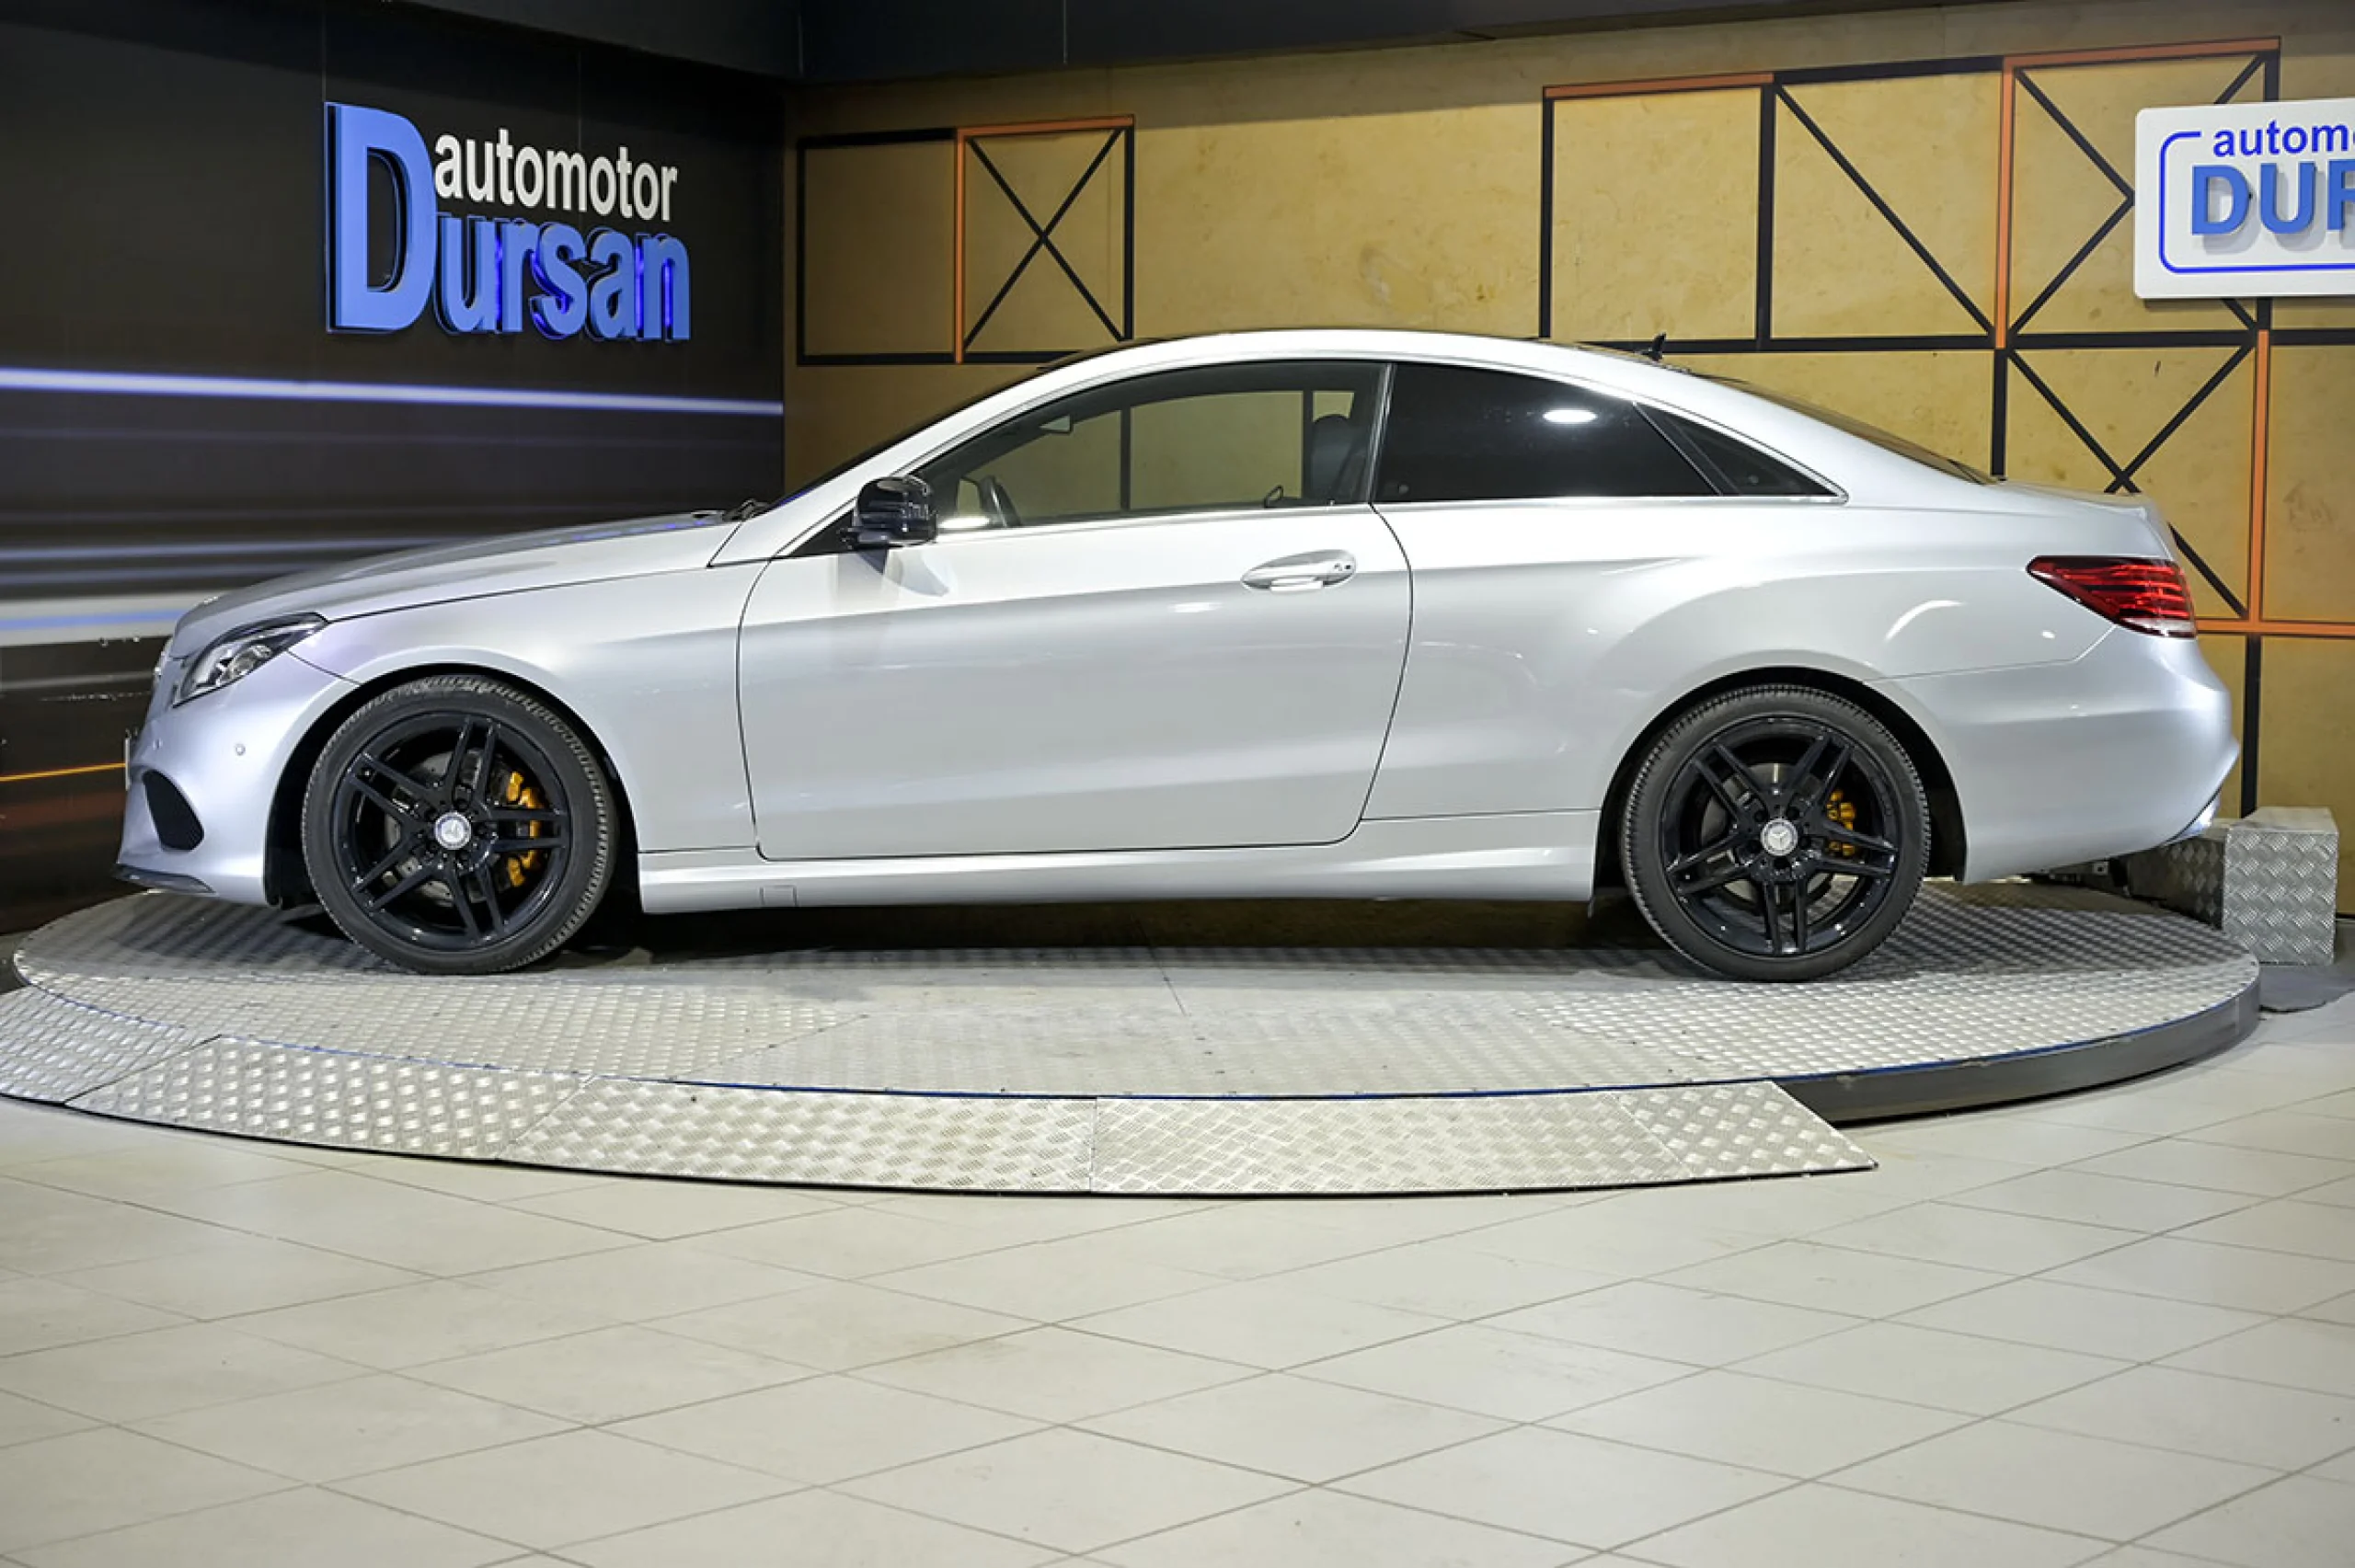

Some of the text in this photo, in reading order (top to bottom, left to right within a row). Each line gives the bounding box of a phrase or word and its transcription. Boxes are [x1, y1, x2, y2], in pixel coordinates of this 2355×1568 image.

[434, 128, 679, 222] automotor
[2212, 120, 2355, 158] autom
[325, 102, 691, 342] Dursan
